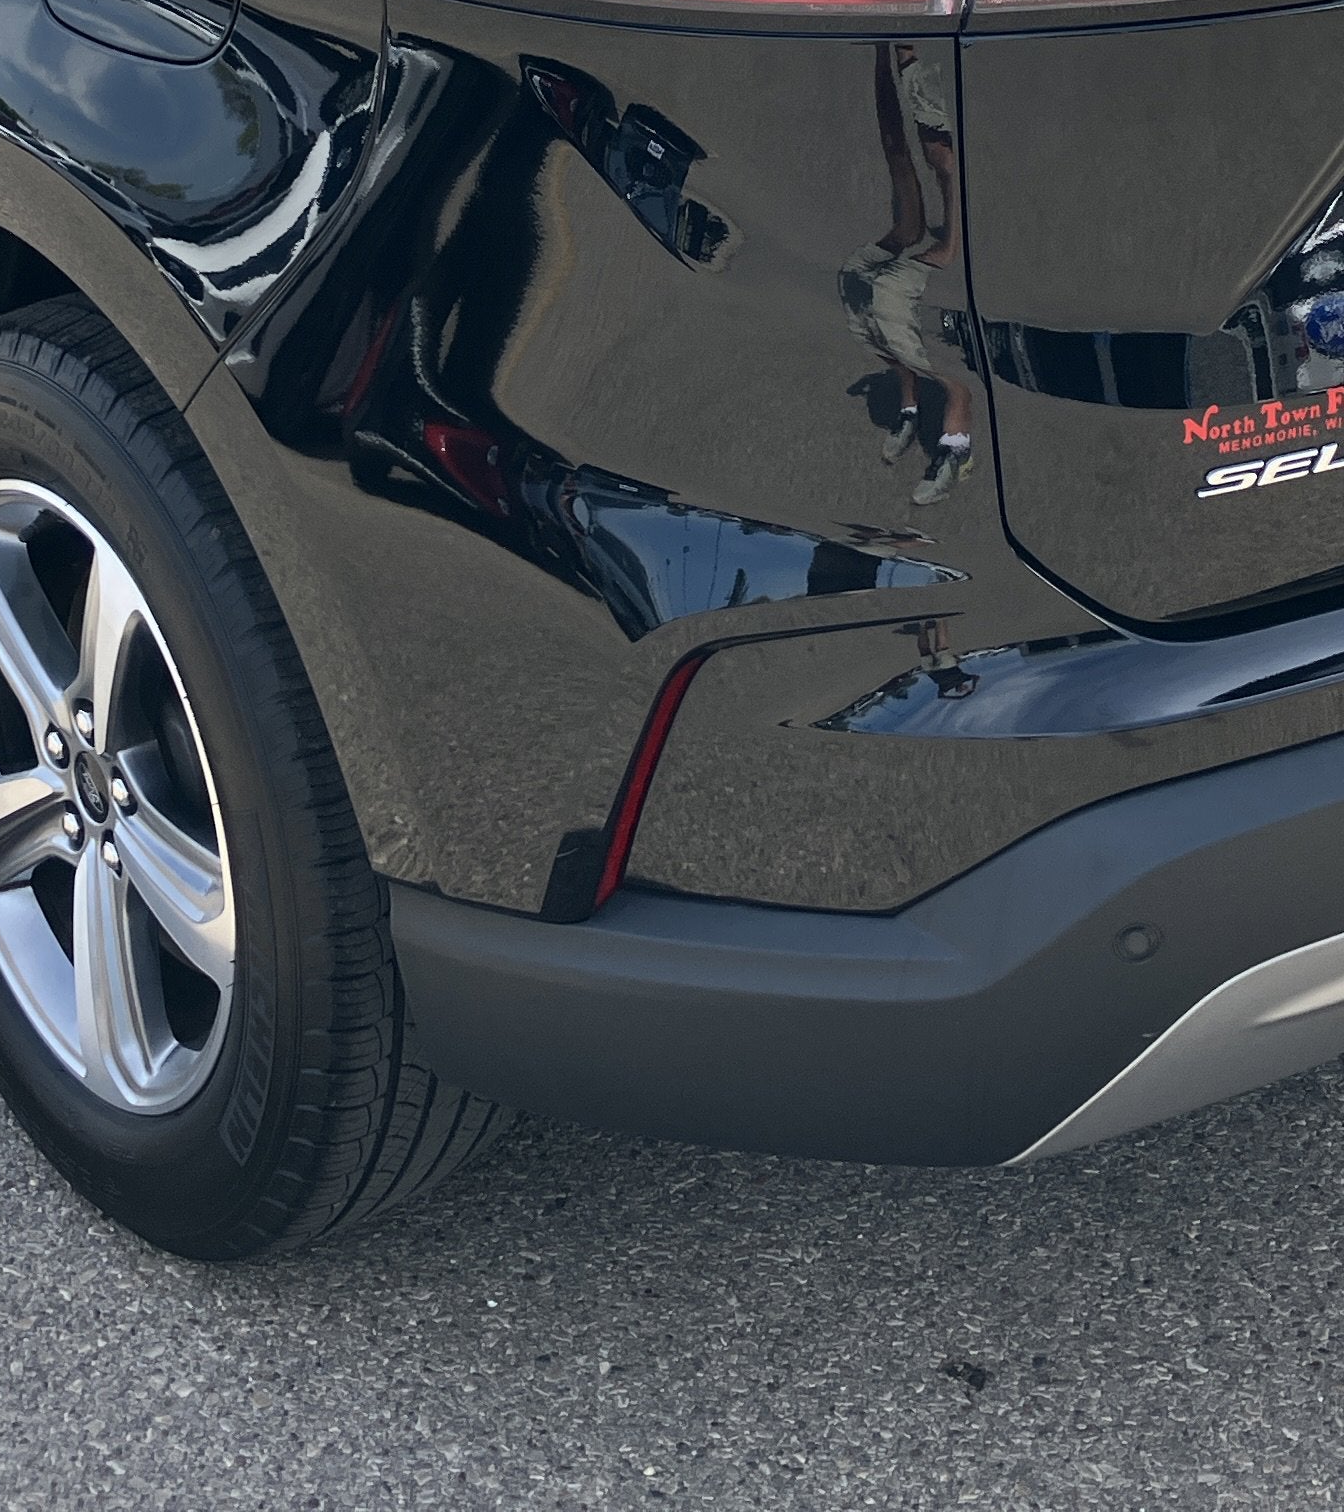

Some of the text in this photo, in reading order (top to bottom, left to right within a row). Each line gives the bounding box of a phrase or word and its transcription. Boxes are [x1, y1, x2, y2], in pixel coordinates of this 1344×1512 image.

[1182, 403, 1256, 445] North
[1261, 400, 1322, 429] Town
[1218, 416, 1344, 454] MENOMONIE, WI
